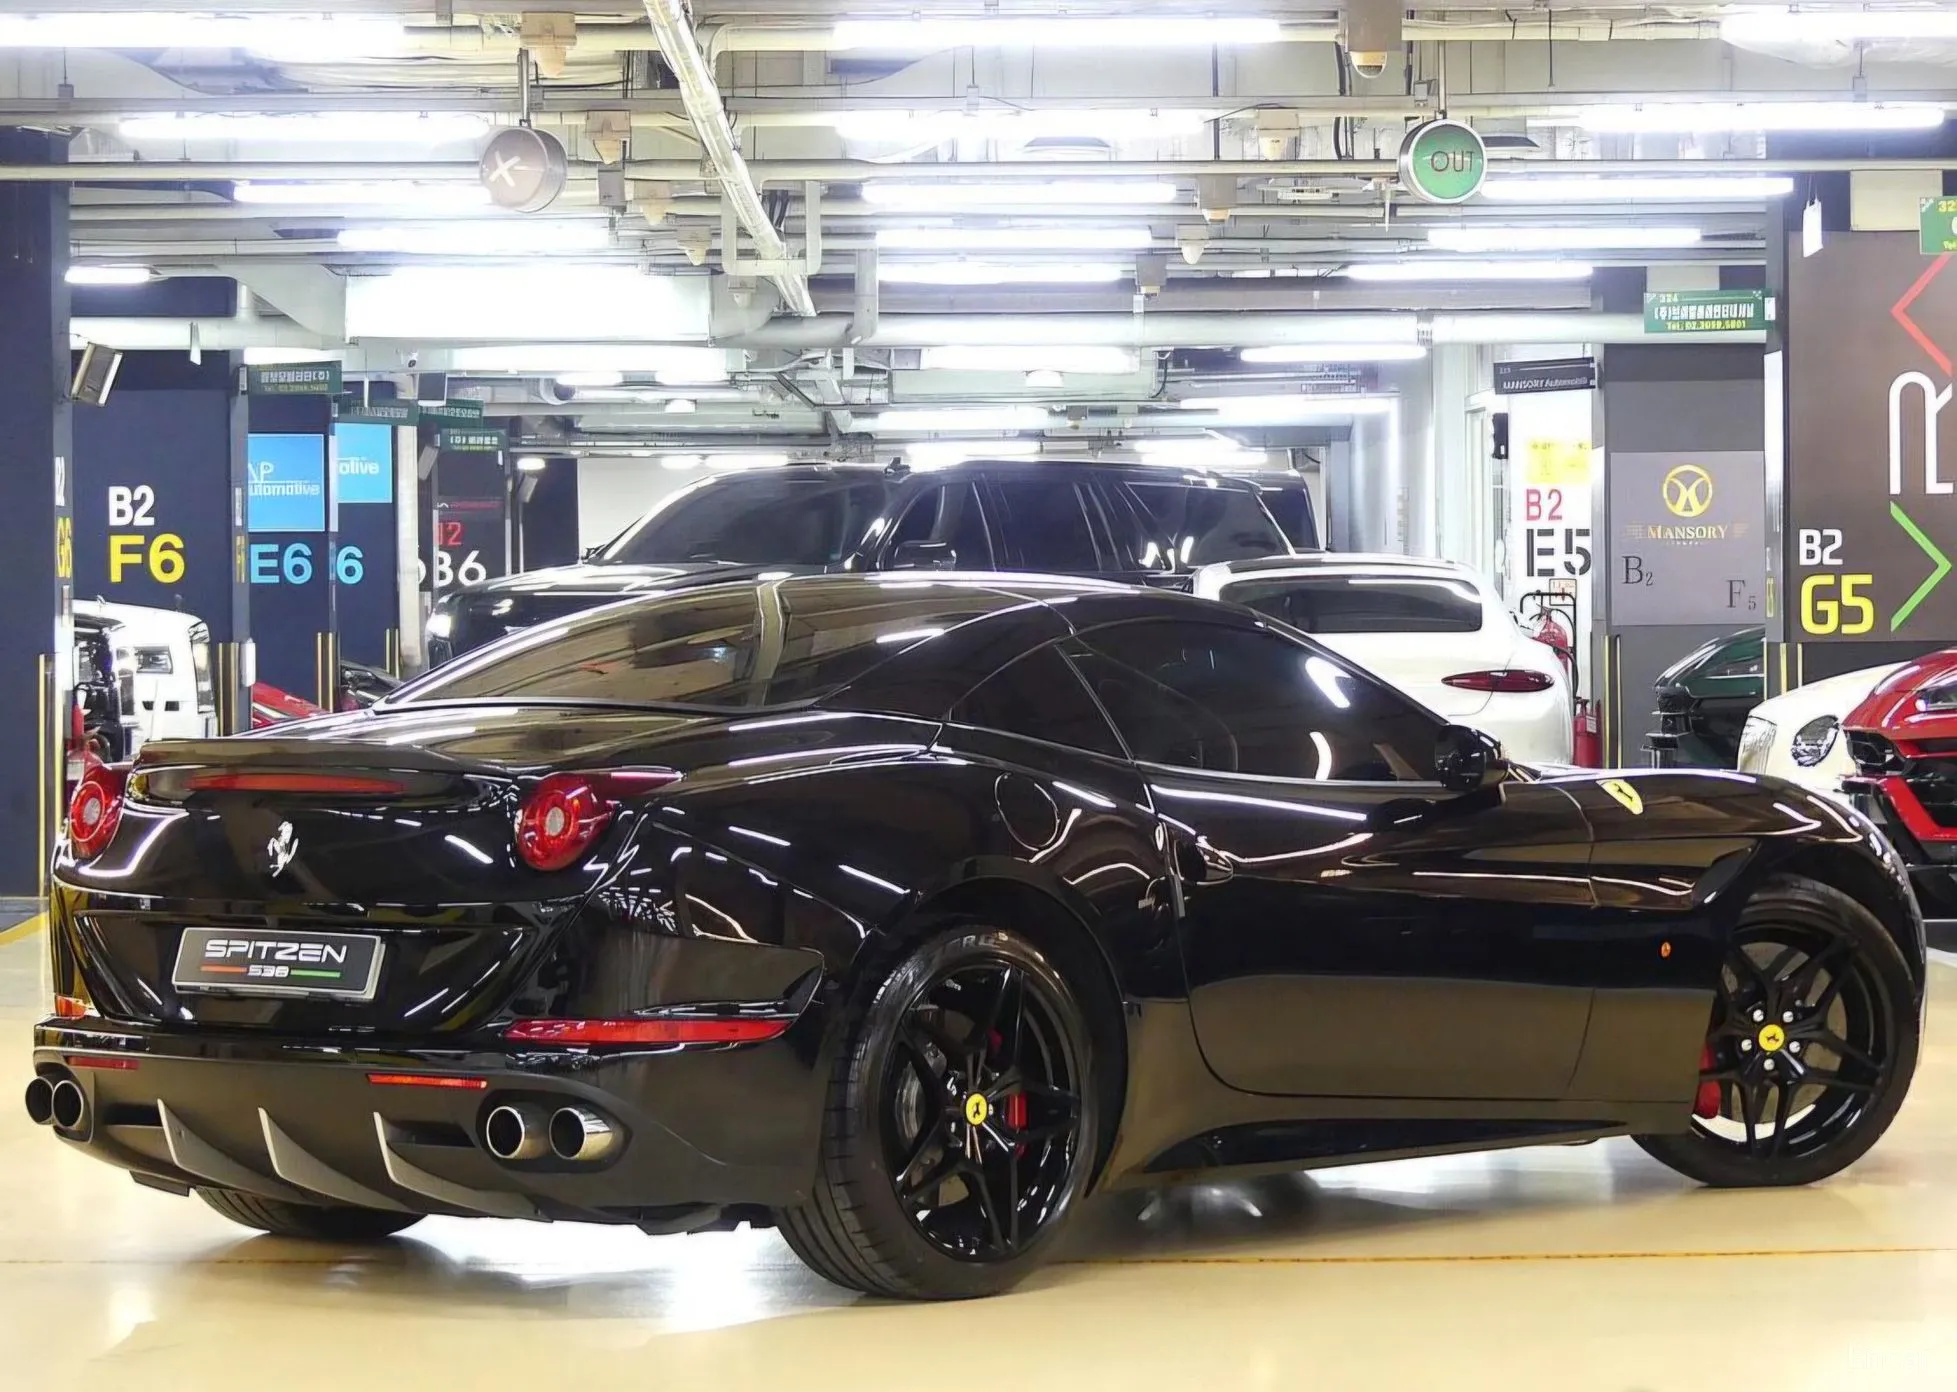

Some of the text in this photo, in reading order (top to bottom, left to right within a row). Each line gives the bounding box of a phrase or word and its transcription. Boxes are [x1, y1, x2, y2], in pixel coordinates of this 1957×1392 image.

[1430, 150, 1475, 173] OUT
[338, 459, 380, 475] otive
[108, 485, 155, 526] B2
[248, 482, 321, 497] utomotive
[1526, 488, 1563, 521] B2
[1647, 524, 1728, 540] MANSORY
[1799, 528, 1844, 566] B2
[110, 533, 186, 584] F6
[250, 542, 313, 585] E6
[1526, 528, 1592, 577] E5
[1800, 573, 1875, 636] G5
[204, 938, 348, 965] SPITZEN
